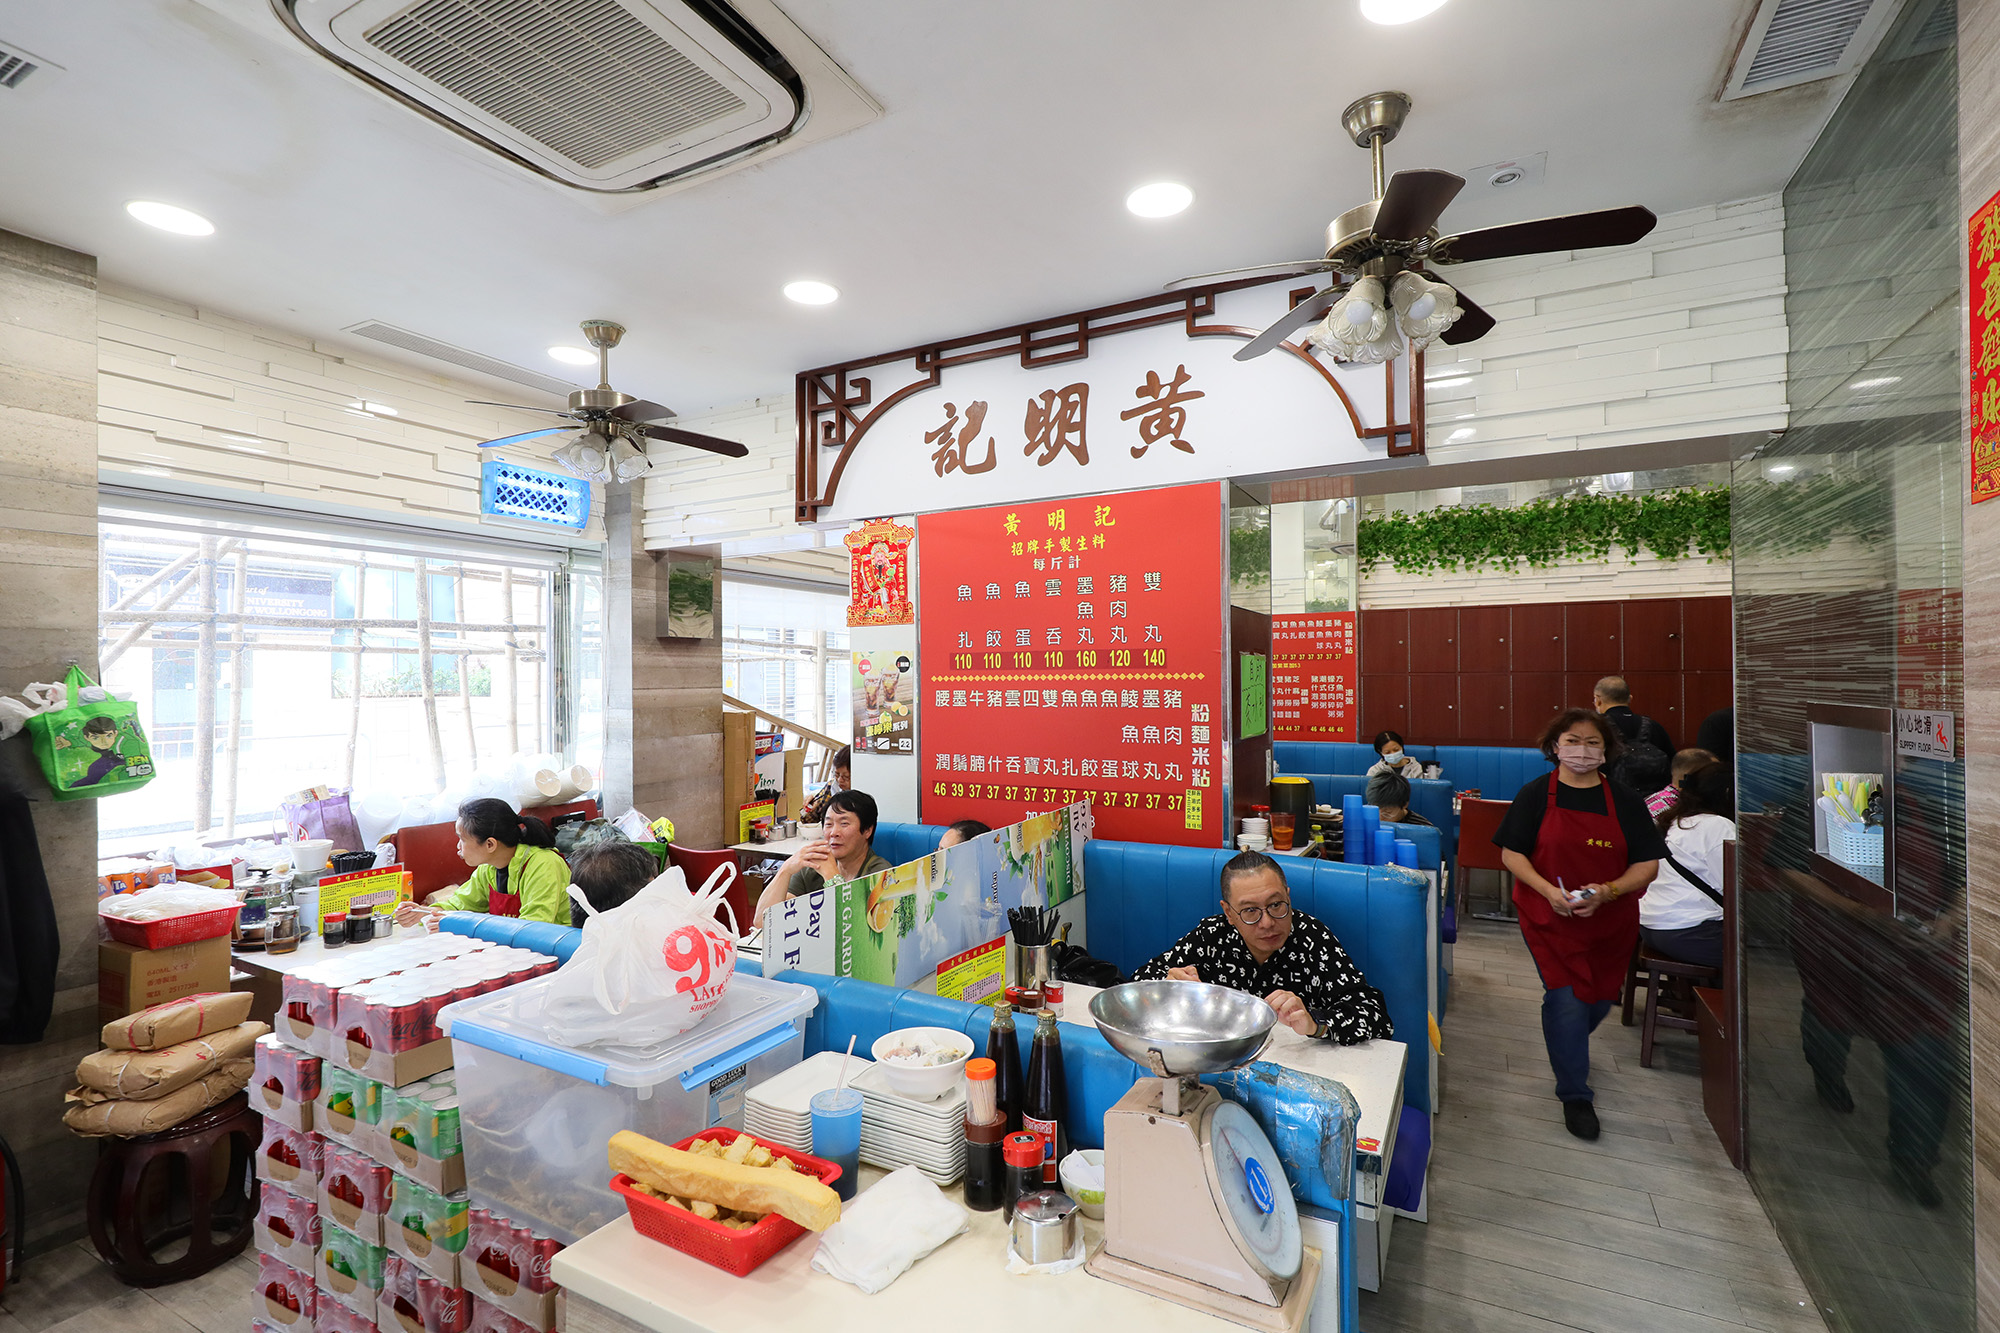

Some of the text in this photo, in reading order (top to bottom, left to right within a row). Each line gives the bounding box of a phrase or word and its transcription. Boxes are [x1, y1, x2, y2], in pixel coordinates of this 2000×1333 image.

[1003, 505, 1116, 536] 黃明記
[1011, 533, 1106, 556] 招牌手製生料
[1033, 555, 1082, 571] 每斤計
[248, 597, 305, 608] NIVERSITY
[256, 605, 328, 617] WOLLONGONG
[954, 649, 1165, 669] 110 110 110 110 160 120 140
[1899, 714, 1932, 736] 小心地滑
[1190, 703, 1210, 788] 粉麵米粘
[1899, 740, 1931, 753] SLIPPERY FLOOR
[125, 763, 153, 777] 10
[126, 755, 149, 766] BEN
[934, 782, 1183, 810] 46 39 37 37 37 37 37 37 37 37 37 37 37
[784, 899, 799, 920] et
[806, 890, 825, 938] Day
[842, 907, 852, 977] GAARD
